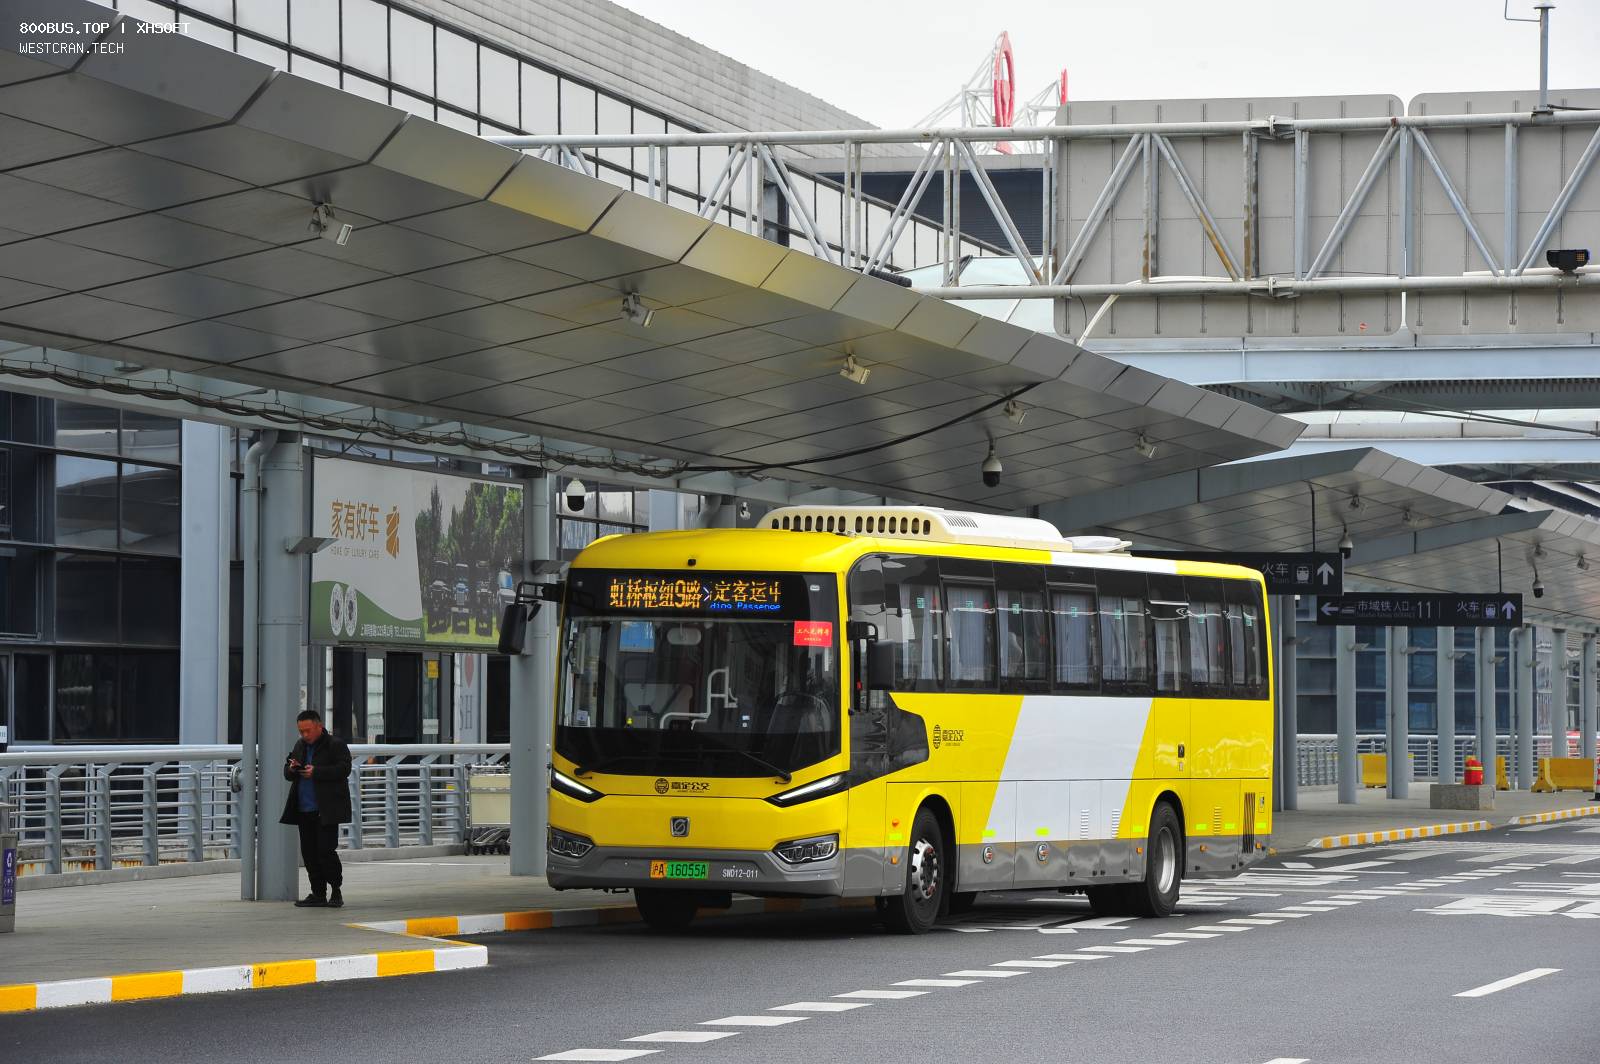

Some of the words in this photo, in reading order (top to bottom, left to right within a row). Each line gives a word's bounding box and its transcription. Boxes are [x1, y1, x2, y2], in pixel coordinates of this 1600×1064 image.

[331, 498, 380, 542] 家有好车
[1261, 561, 1289, 576] 火车
[1457, 601, 1480, 612] 火车
